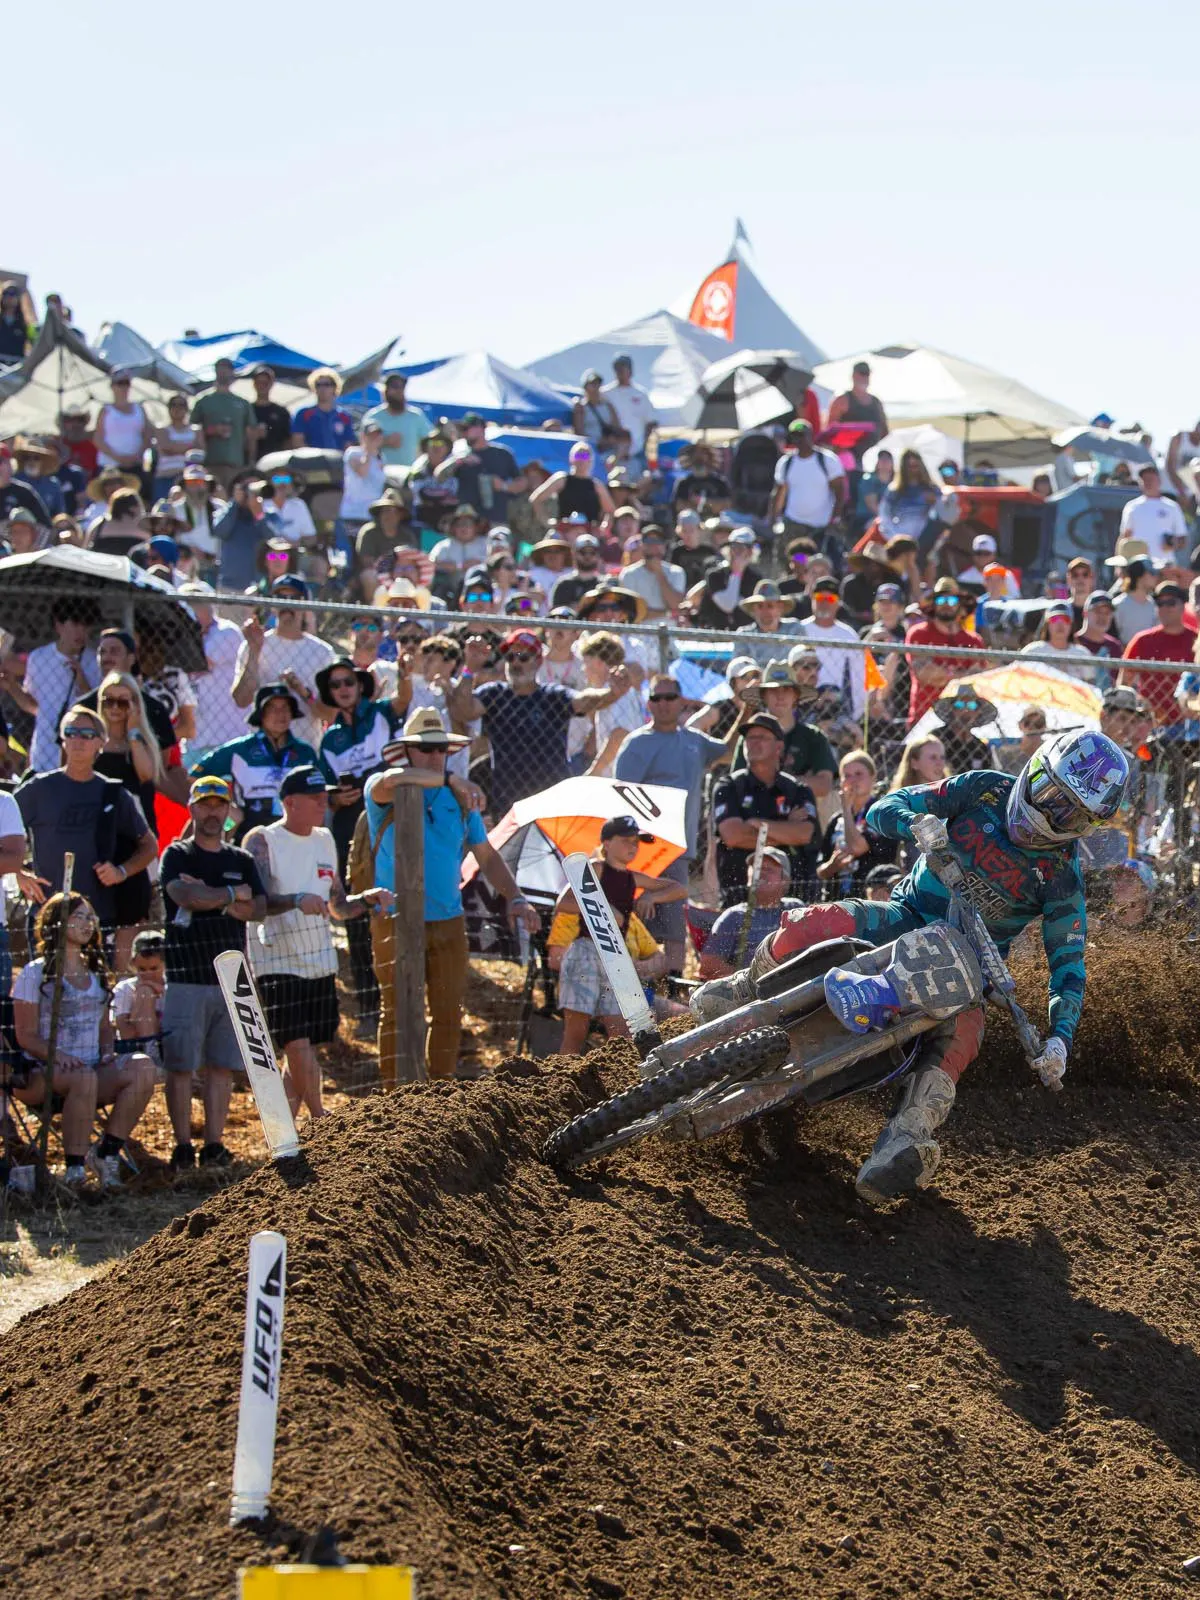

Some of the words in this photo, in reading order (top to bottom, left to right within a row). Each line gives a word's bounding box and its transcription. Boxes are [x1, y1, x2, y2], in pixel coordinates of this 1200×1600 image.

[581, 897, 617, 954] UFO
[834, 990, 849, 1020] YAMAHA
[895, 932, 970, 1013] 39
[234, 1001, 270, 1070] UFO
[251, 1007, 276, 1073] PLAST
[251, 1297, 275, 1395] UFO
